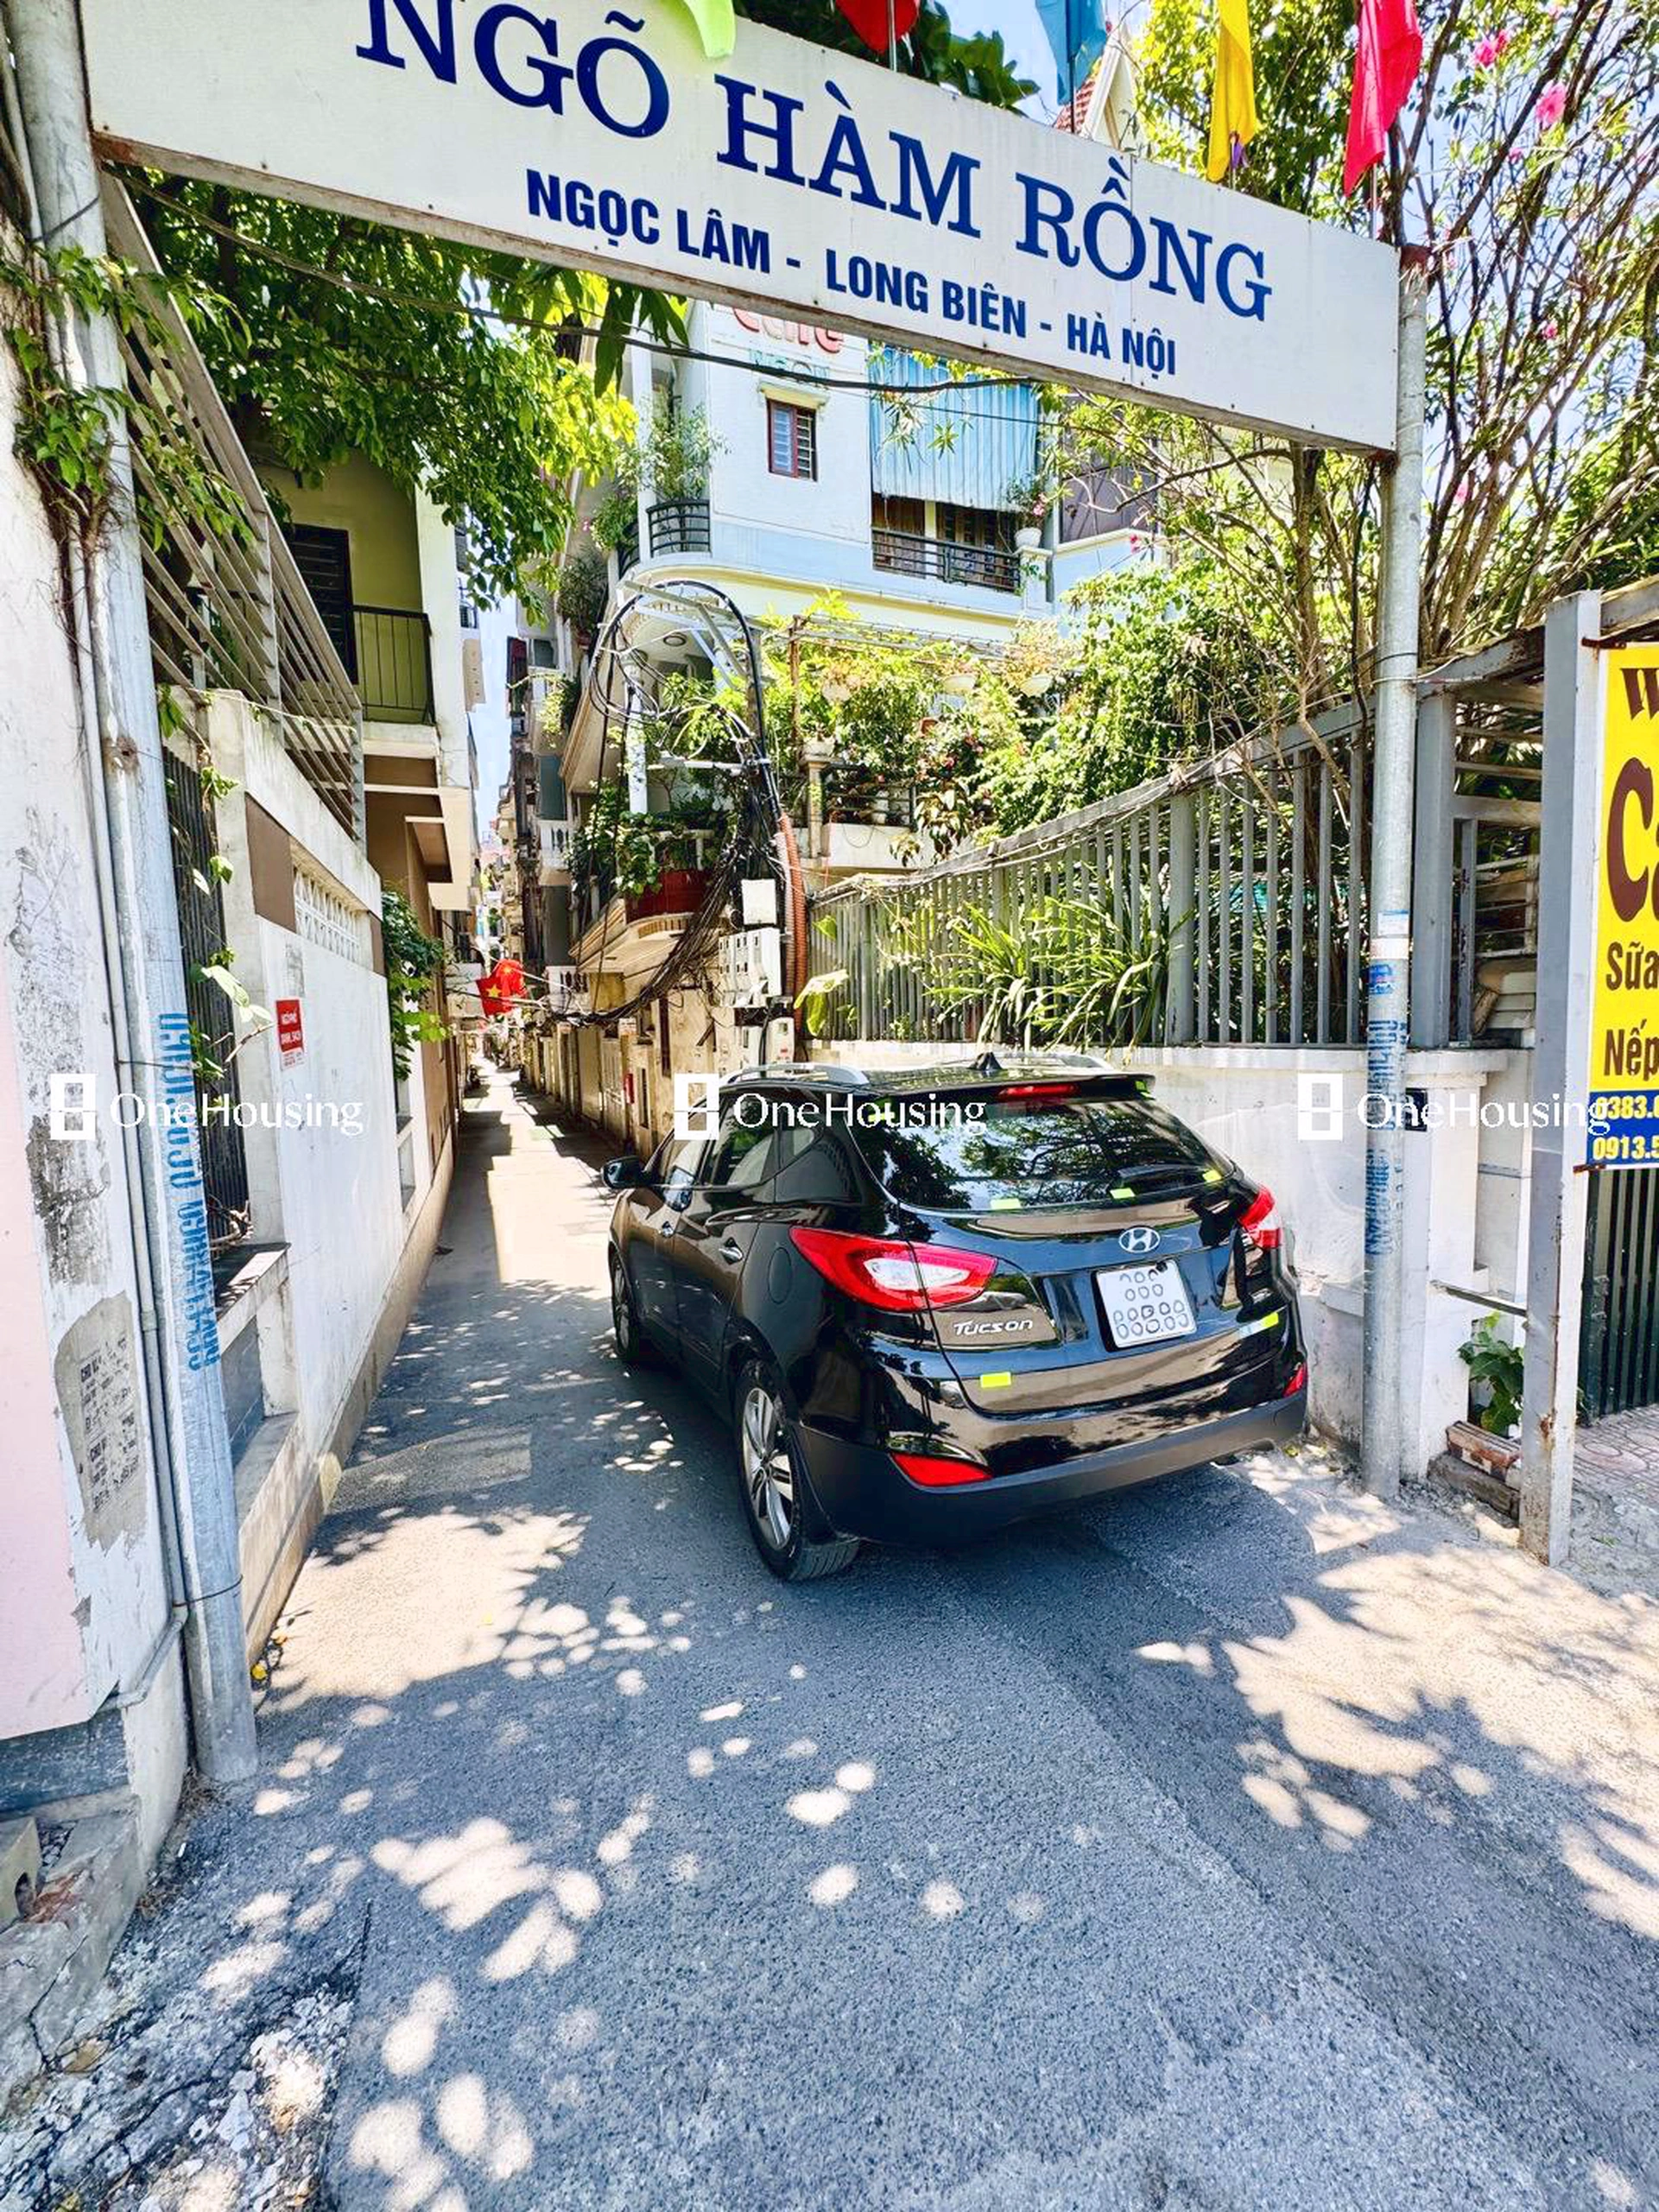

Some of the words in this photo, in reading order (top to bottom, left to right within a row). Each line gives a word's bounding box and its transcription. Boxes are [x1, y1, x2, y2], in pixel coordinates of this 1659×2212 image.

[356, 0, 670, 138] NGÕ
[714, 73, 981, 239] HÀM
[1015, 156, 1273, 322] RỒNG
[526, 168, 660, 247] NGỌC
[677, 207, 770, 275] LÂM
[826, 248, 928, 314] LONG
[941, 277, 1027, 339] BIÊN
[1067, 312, 1111, 360] HÀ
[1122, 327, 1177, 381] NỘI
[1606, 757, 1659, 922] C
[1605, 941, 1659, 992] Sữa
[1604, 1019, 1659, 1081] Nếp
